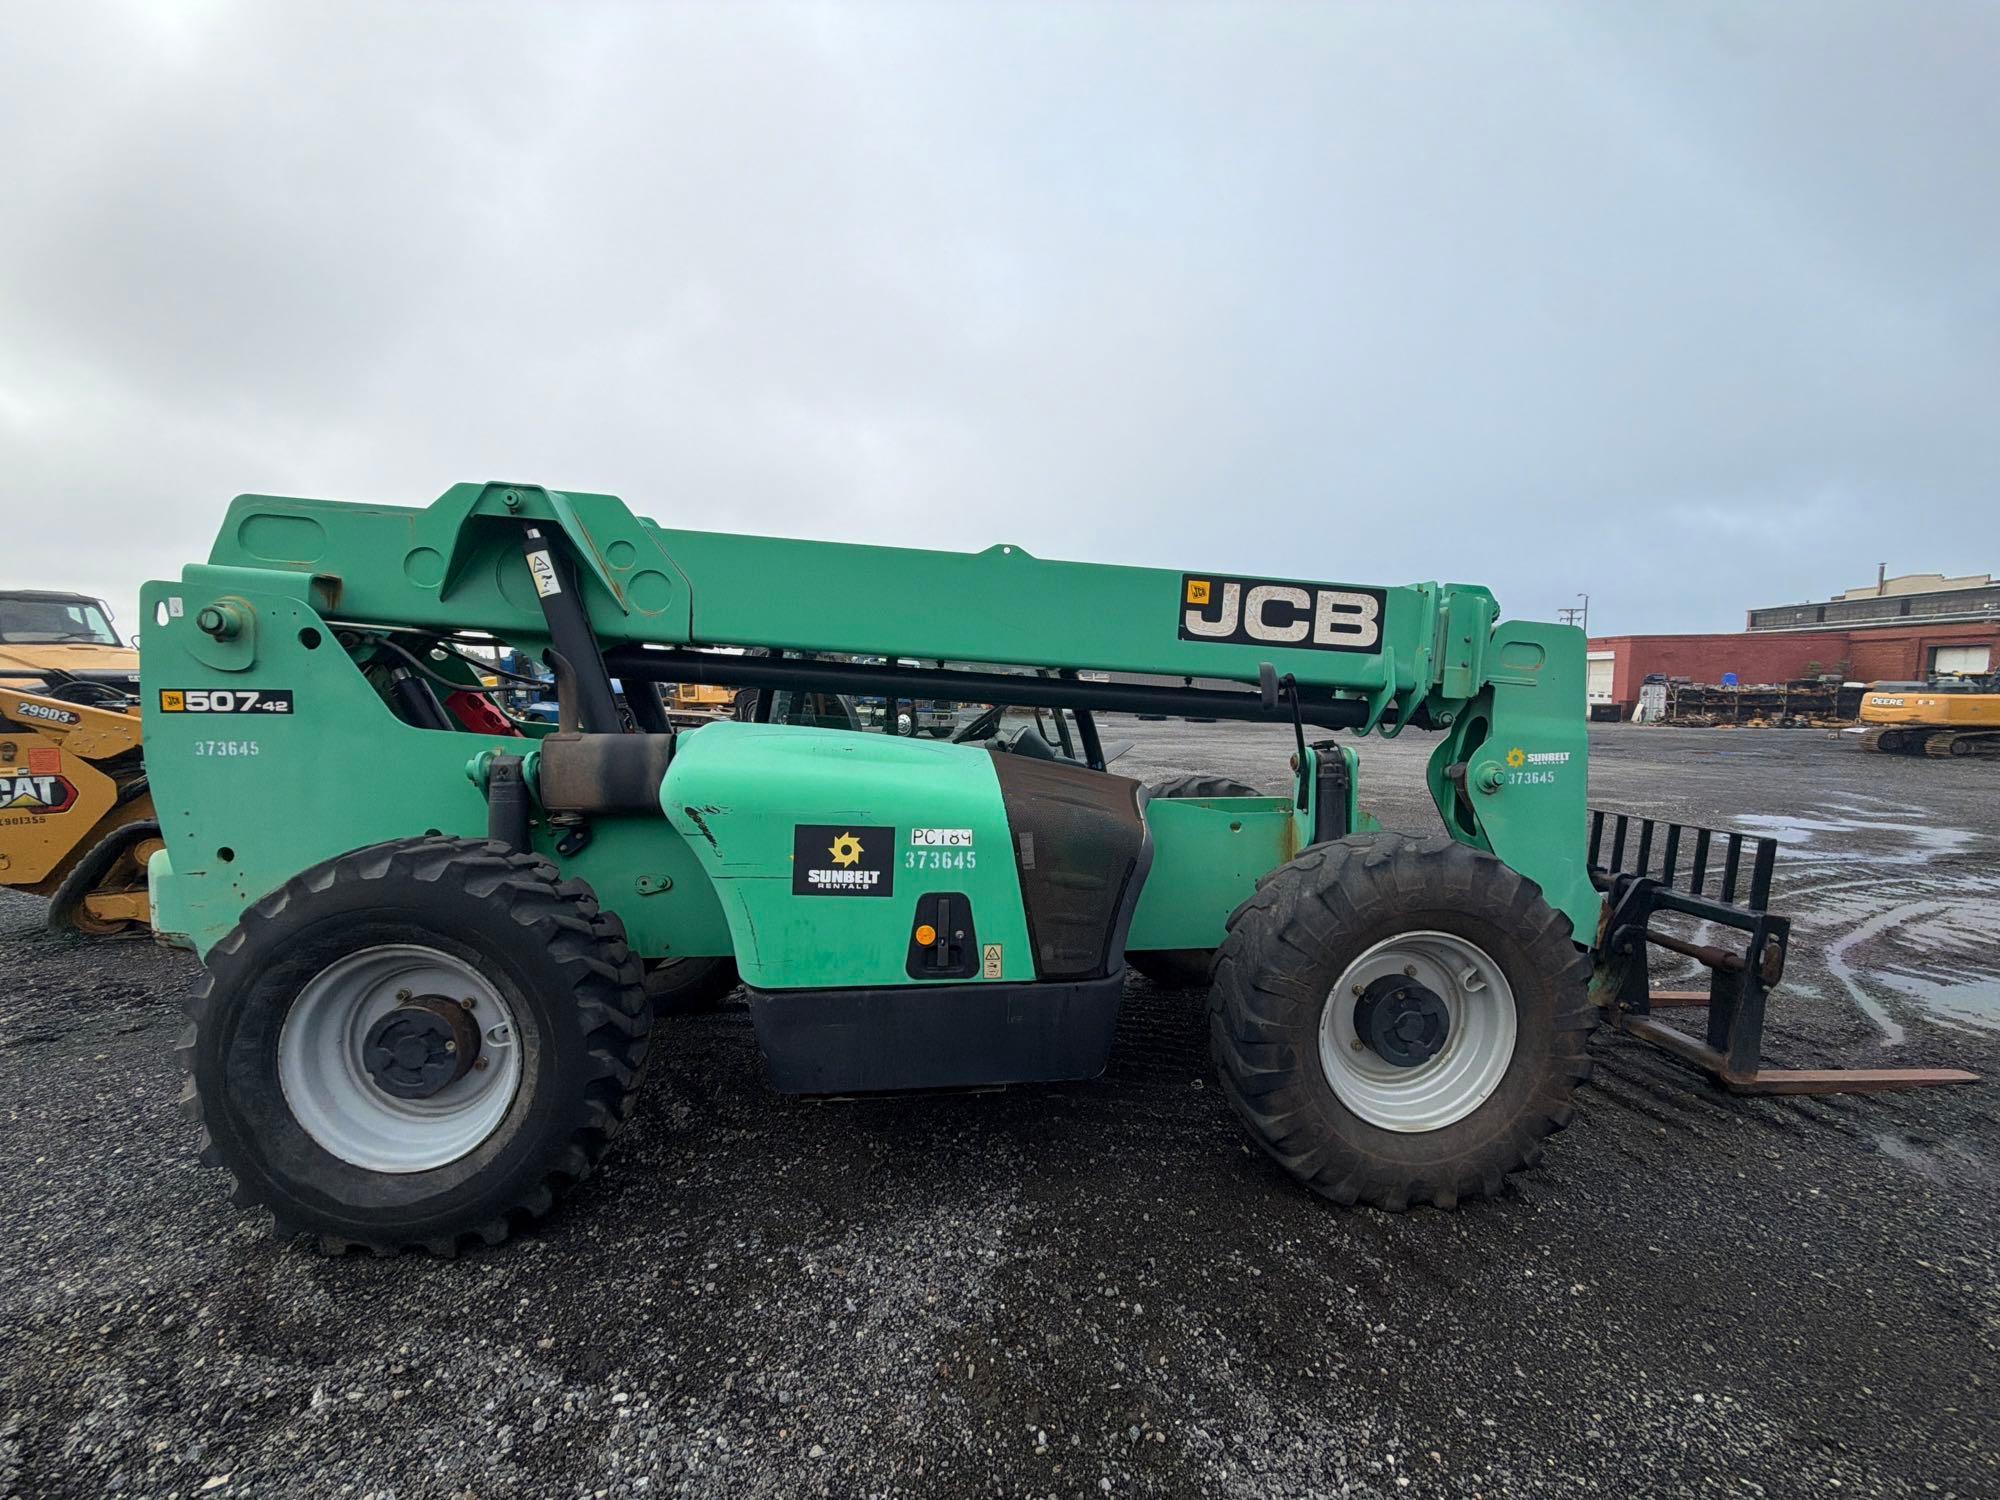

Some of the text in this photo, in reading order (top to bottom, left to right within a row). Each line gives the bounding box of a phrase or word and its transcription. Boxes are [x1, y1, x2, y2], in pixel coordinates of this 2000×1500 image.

[1185, 582, 1380, 648] JCB
[185, 691, 288, 711] 507-42
[1871, 697, 1904, 706] DEERE
[17, 702, 70, 723] 299D3
[195, 741, 259, 756] 373645
[1527, 752, 1571, 762] SUNBELT
[1508, 771, 1554, 785] 373645
[0, 776, 55, 808] CAT
[905, 851, 976, 869] 373645
[808, 869, 880, 884] SUNBELT
